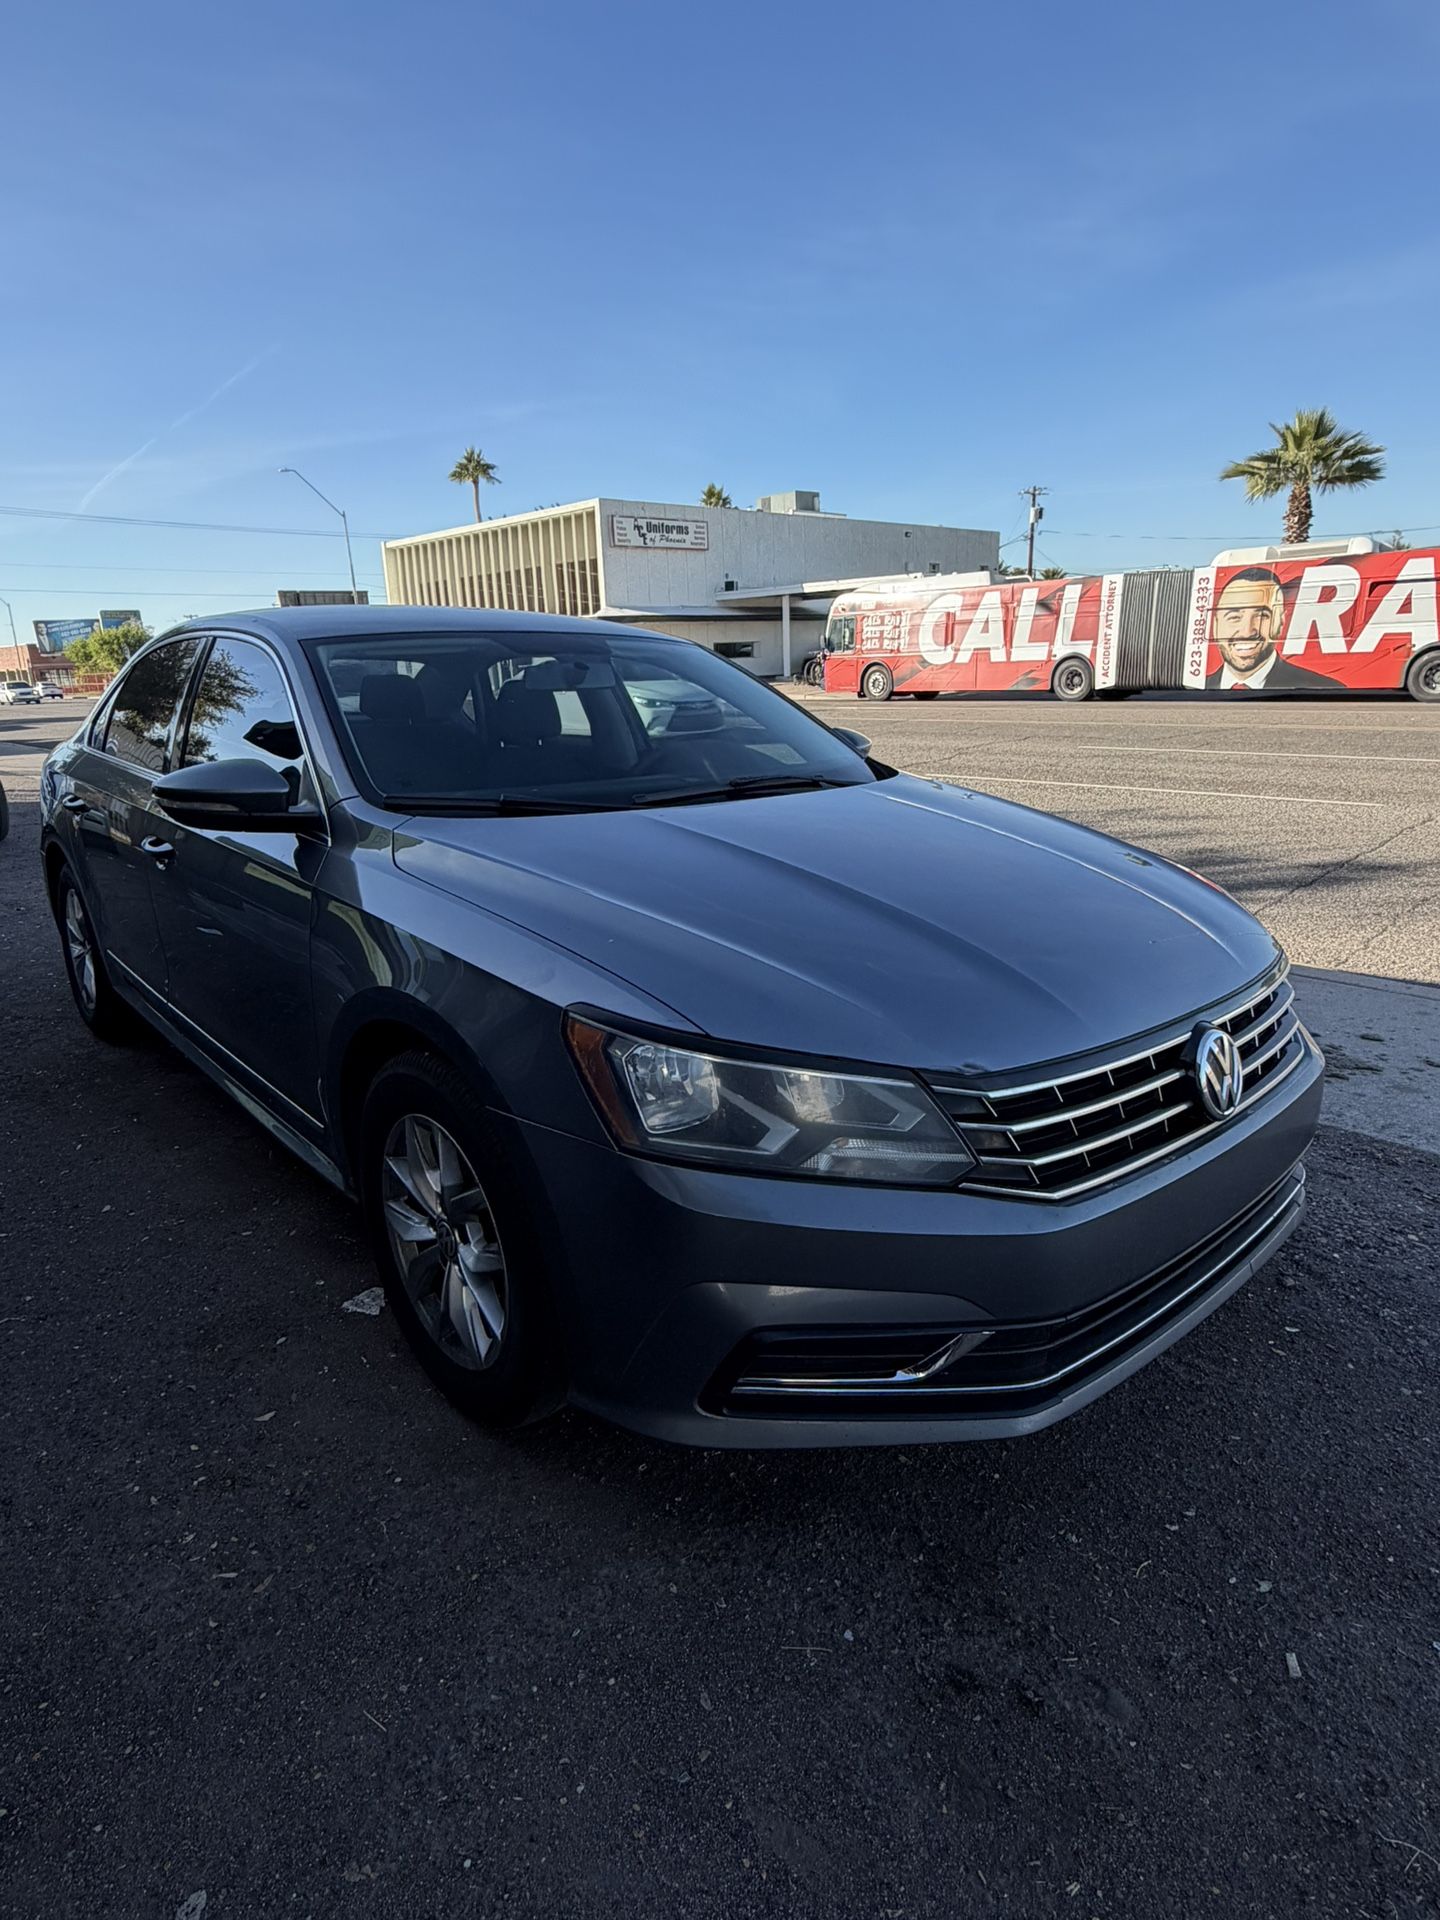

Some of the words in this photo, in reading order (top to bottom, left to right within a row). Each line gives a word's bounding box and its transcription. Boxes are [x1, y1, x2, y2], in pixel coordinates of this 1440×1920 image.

[646, 521, 690, 536] Uniforms
[649, 535, 656, 545] of
[659, 535, 687, 544] Phoenix
[918, 583, 1094, 665] CALL
[1105, 580, 1118, 630] ATTORNEY
[1190, 576, 1210, 677] 623-388-4333
[1101, 632, 1113, 678] ACCIDENT
